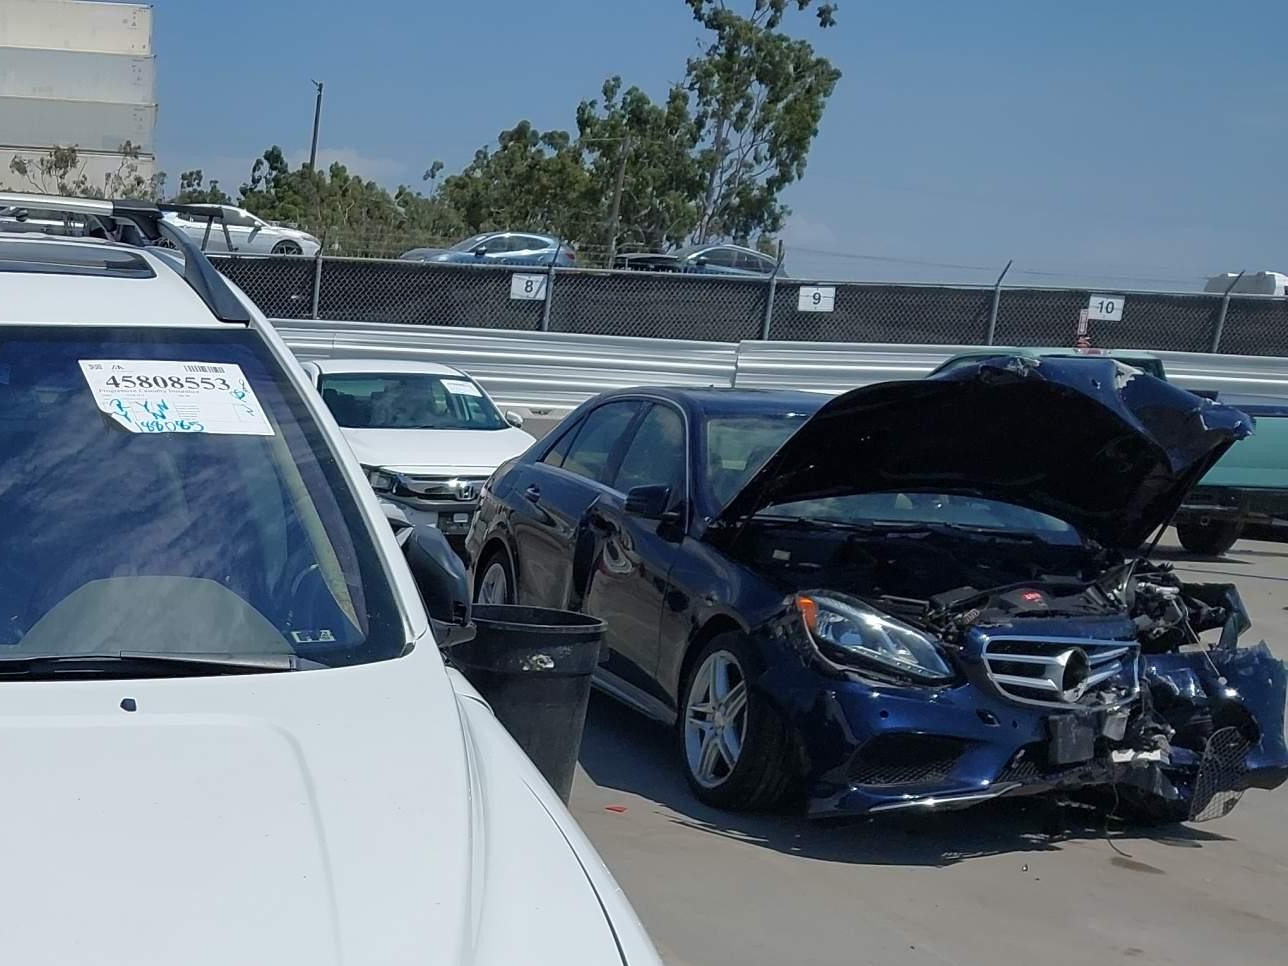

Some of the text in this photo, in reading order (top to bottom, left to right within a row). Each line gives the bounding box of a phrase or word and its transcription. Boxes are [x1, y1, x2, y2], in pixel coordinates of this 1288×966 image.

[524, 280, 533, 293] 8
[812, 292, 821, 305] 9
[1098, 301, 1115, 314] 10
[105, 375, 231, 391] 45808553
